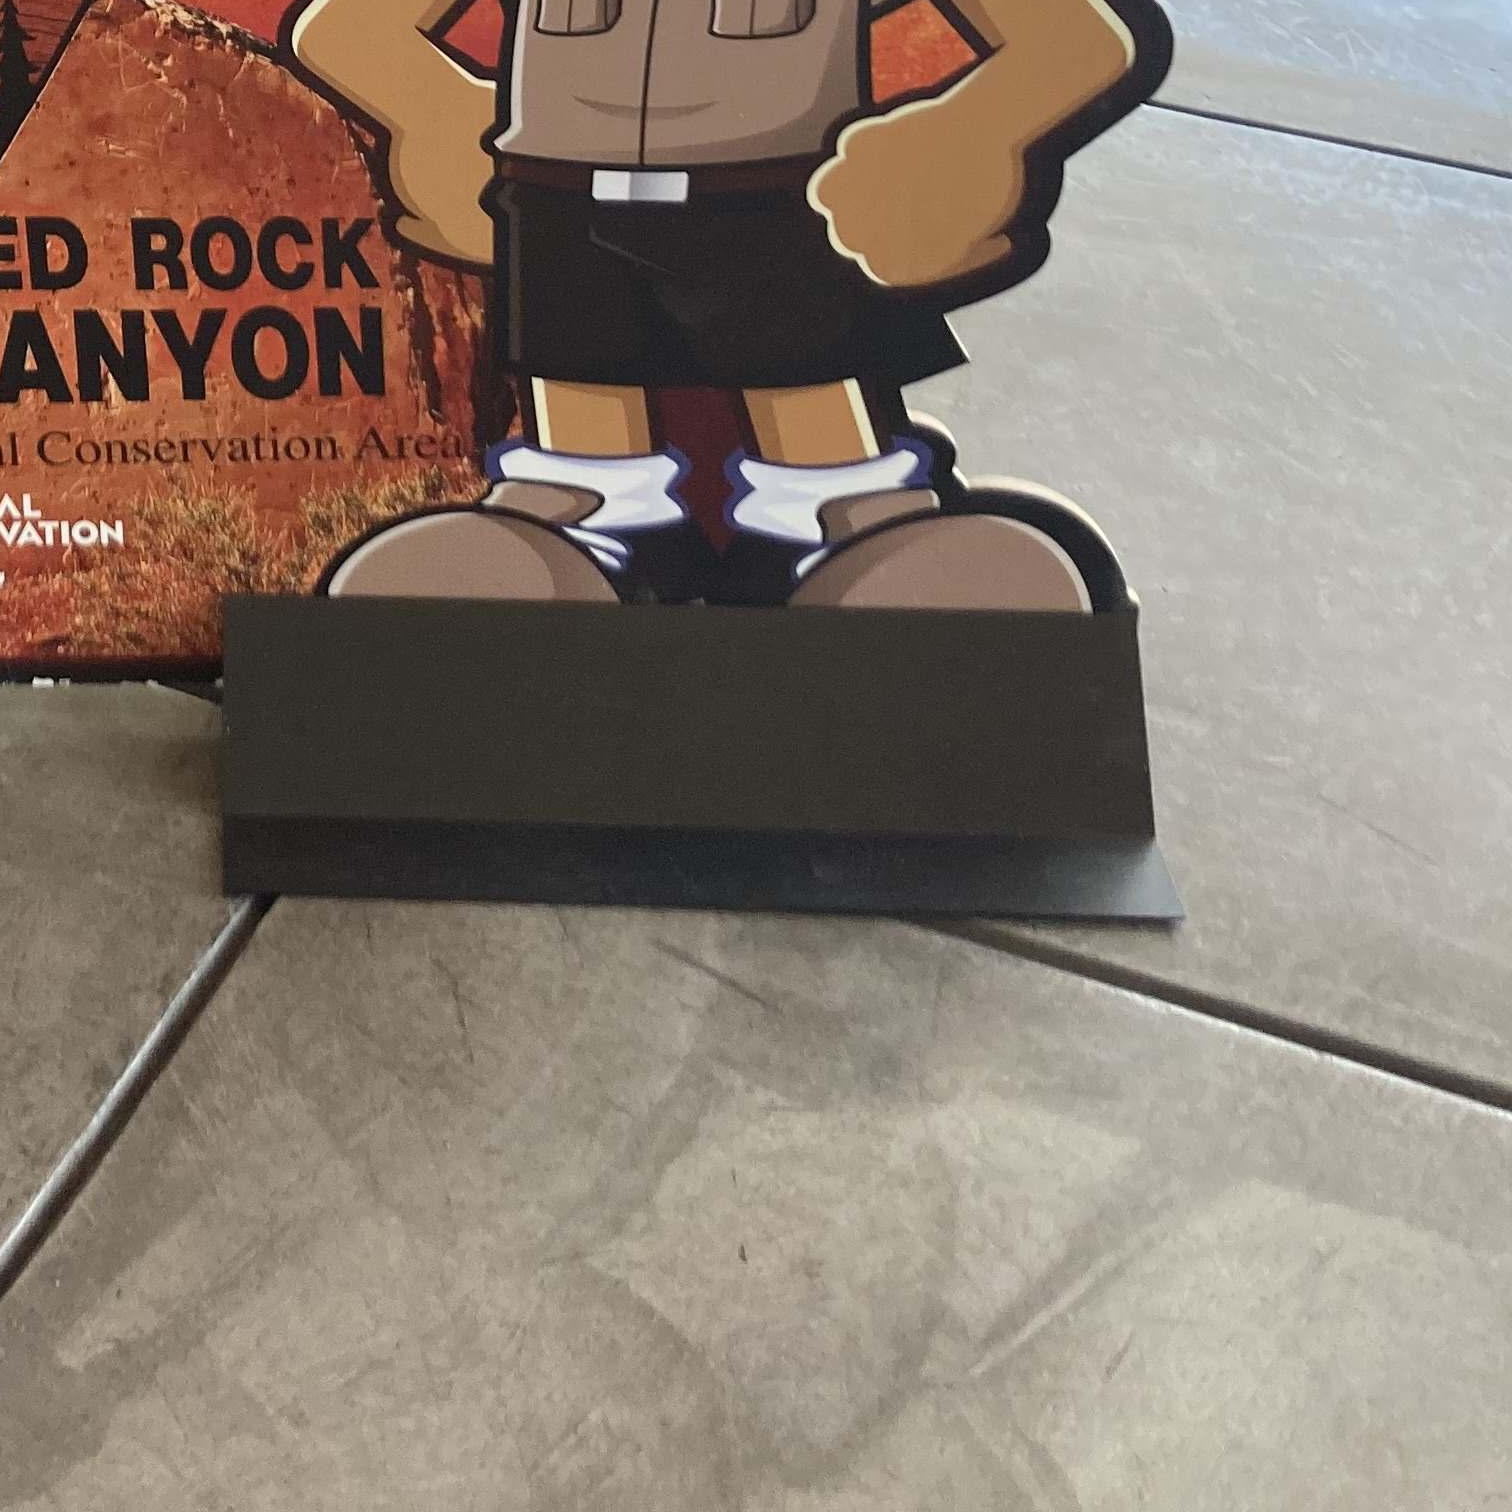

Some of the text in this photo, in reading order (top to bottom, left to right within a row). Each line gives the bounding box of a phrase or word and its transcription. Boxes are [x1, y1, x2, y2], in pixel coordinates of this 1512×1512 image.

[130, 216, 381, 291] ROCK
[35, 426, 339, 467] Conservation
[352, 425, 464, 462] Area
